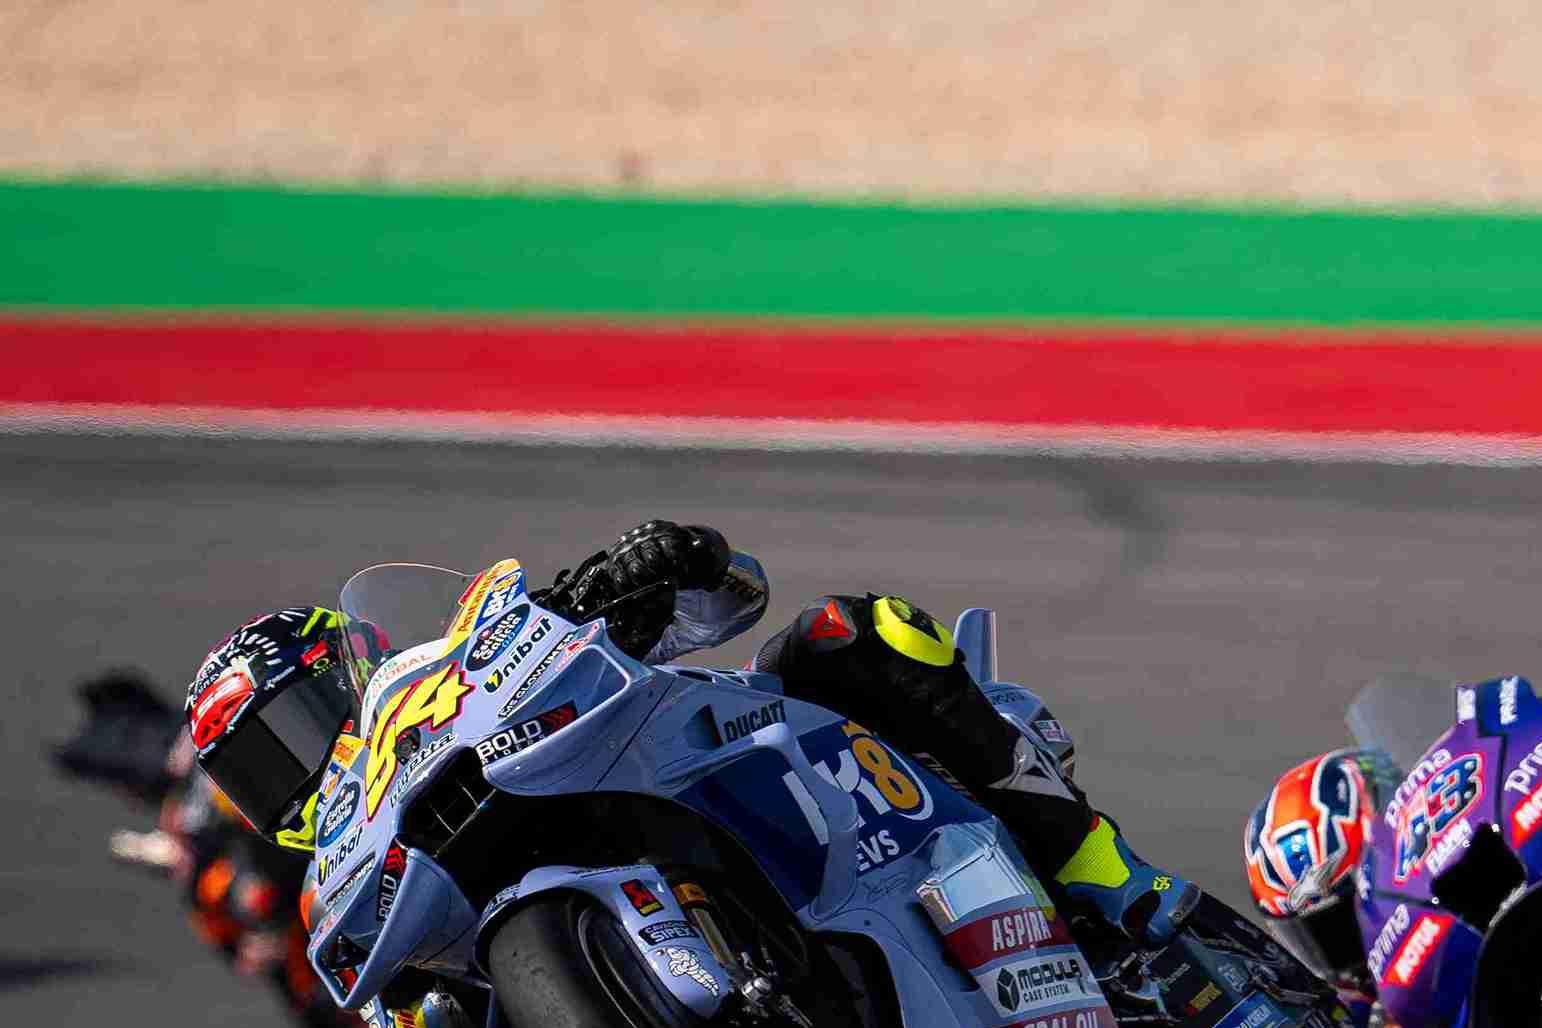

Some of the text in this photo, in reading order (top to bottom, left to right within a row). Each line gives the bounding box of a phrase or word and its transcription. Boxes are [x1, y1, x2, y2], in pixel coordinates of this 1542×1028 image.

[483, 615, 553, 693] Unibat
[365, 661, 476, 820] 54
[475, 719, 542, 758] BOLD
[724, 700, 786, 746] DUCATI
